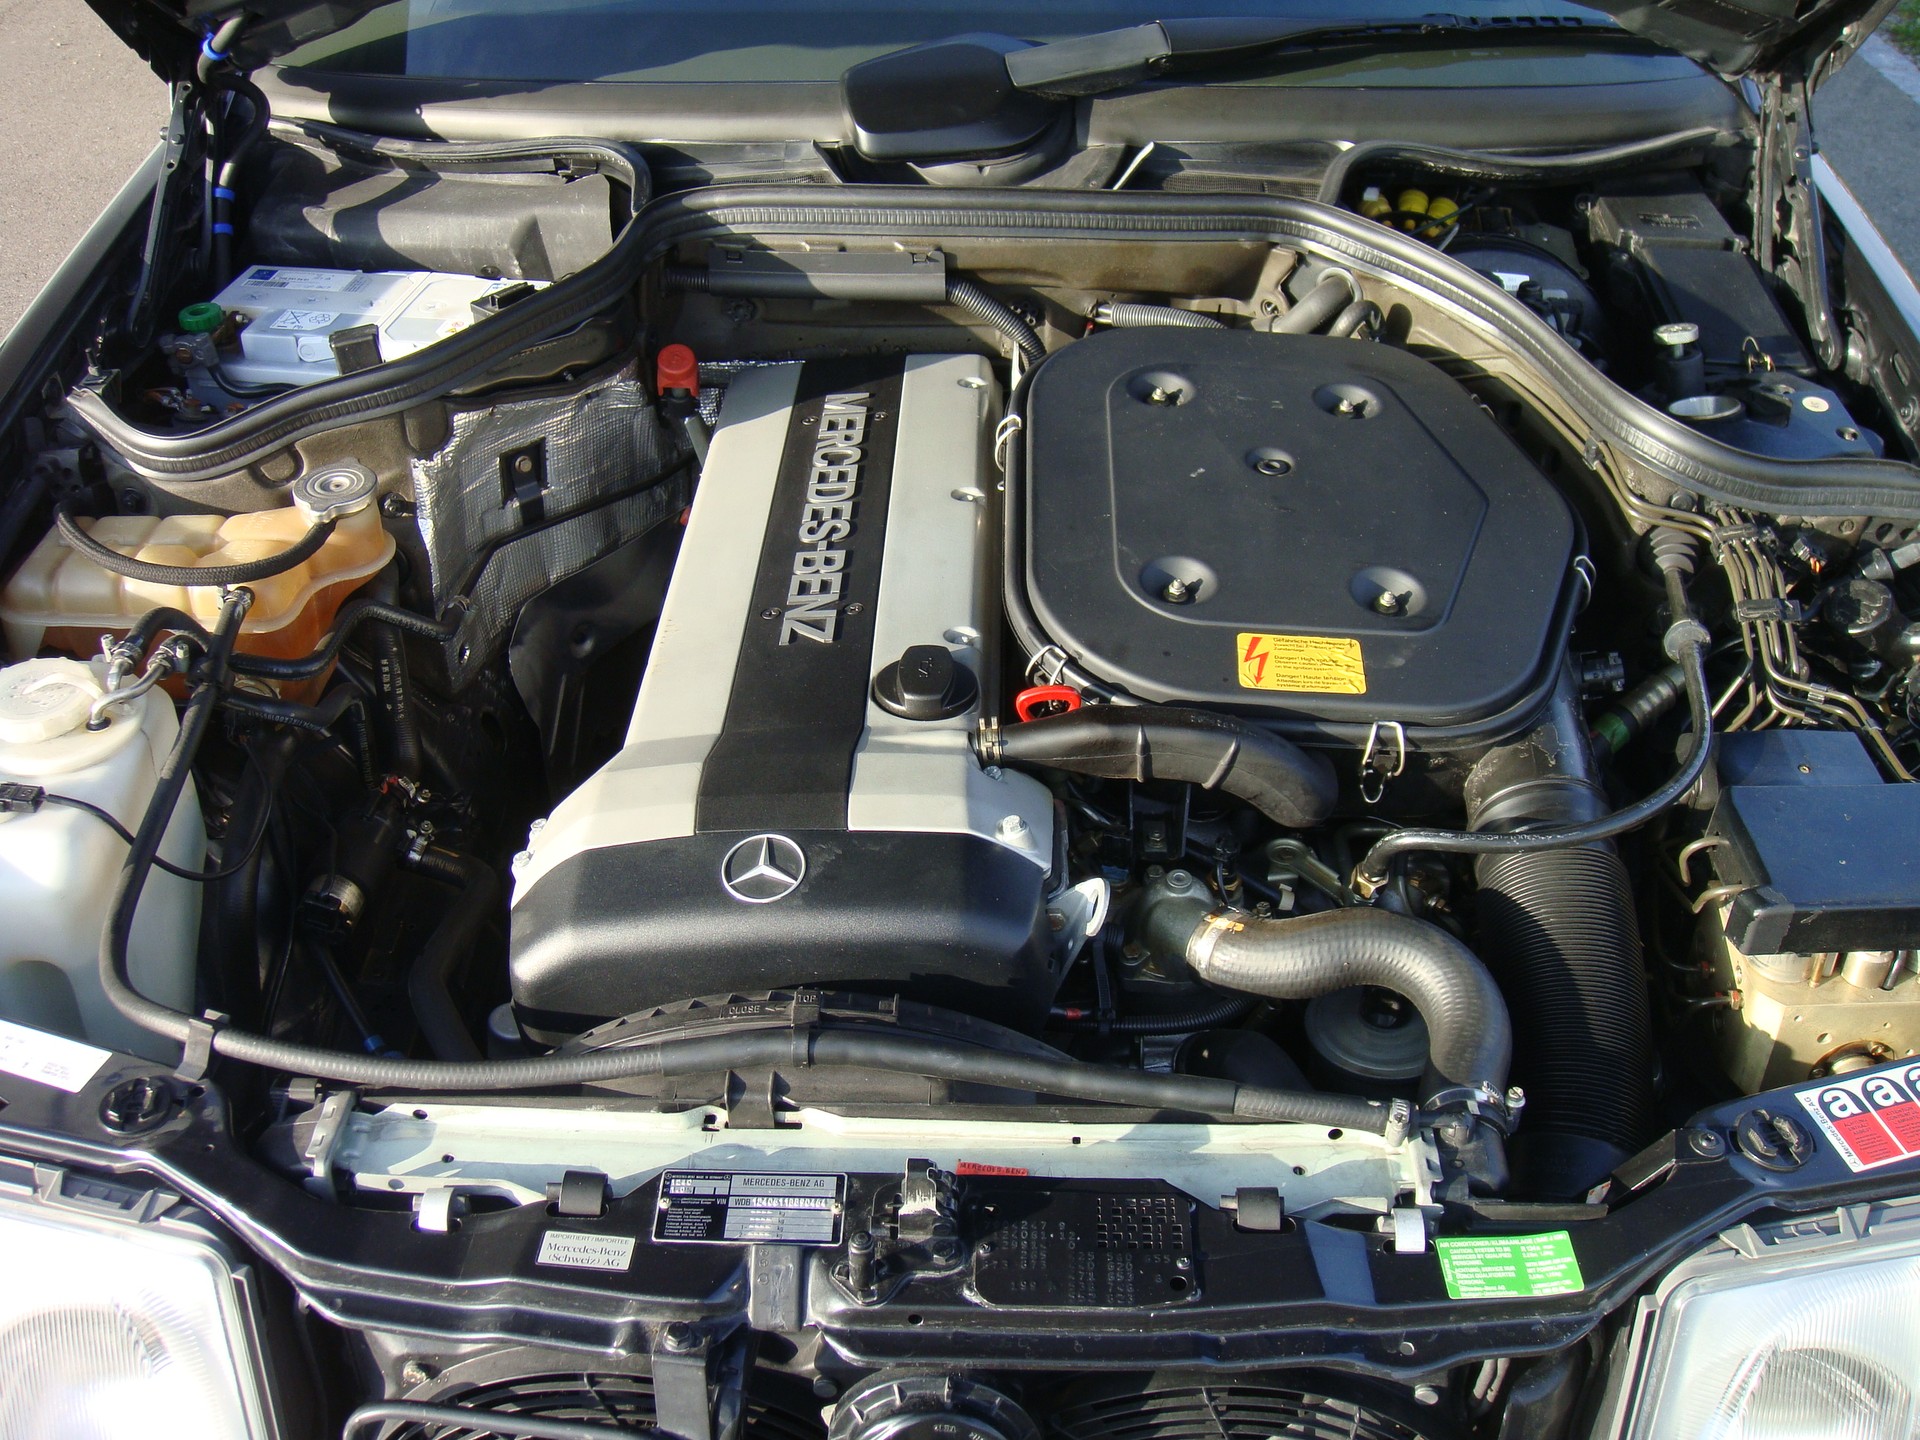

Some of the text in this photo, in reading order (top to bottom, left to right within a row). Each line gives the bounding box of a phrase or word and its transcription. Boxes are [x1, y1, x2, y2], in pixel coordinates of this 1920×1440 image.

[778, 392, 870, 646] MERCEDES-BENZ
[728, 1005, 761, 1015] CLOSE
[1803, 1096, 1854, 1158] Mercedes-Benz AG
[743, 1178, 811, 1187] MERCEDES-BENZ
[734, 1198, 751, 1206] WDB
[547, 1243, 627, 1257] Mercedes-Benz
[548, 1253, 620, 1267] (Schweiz) AG
